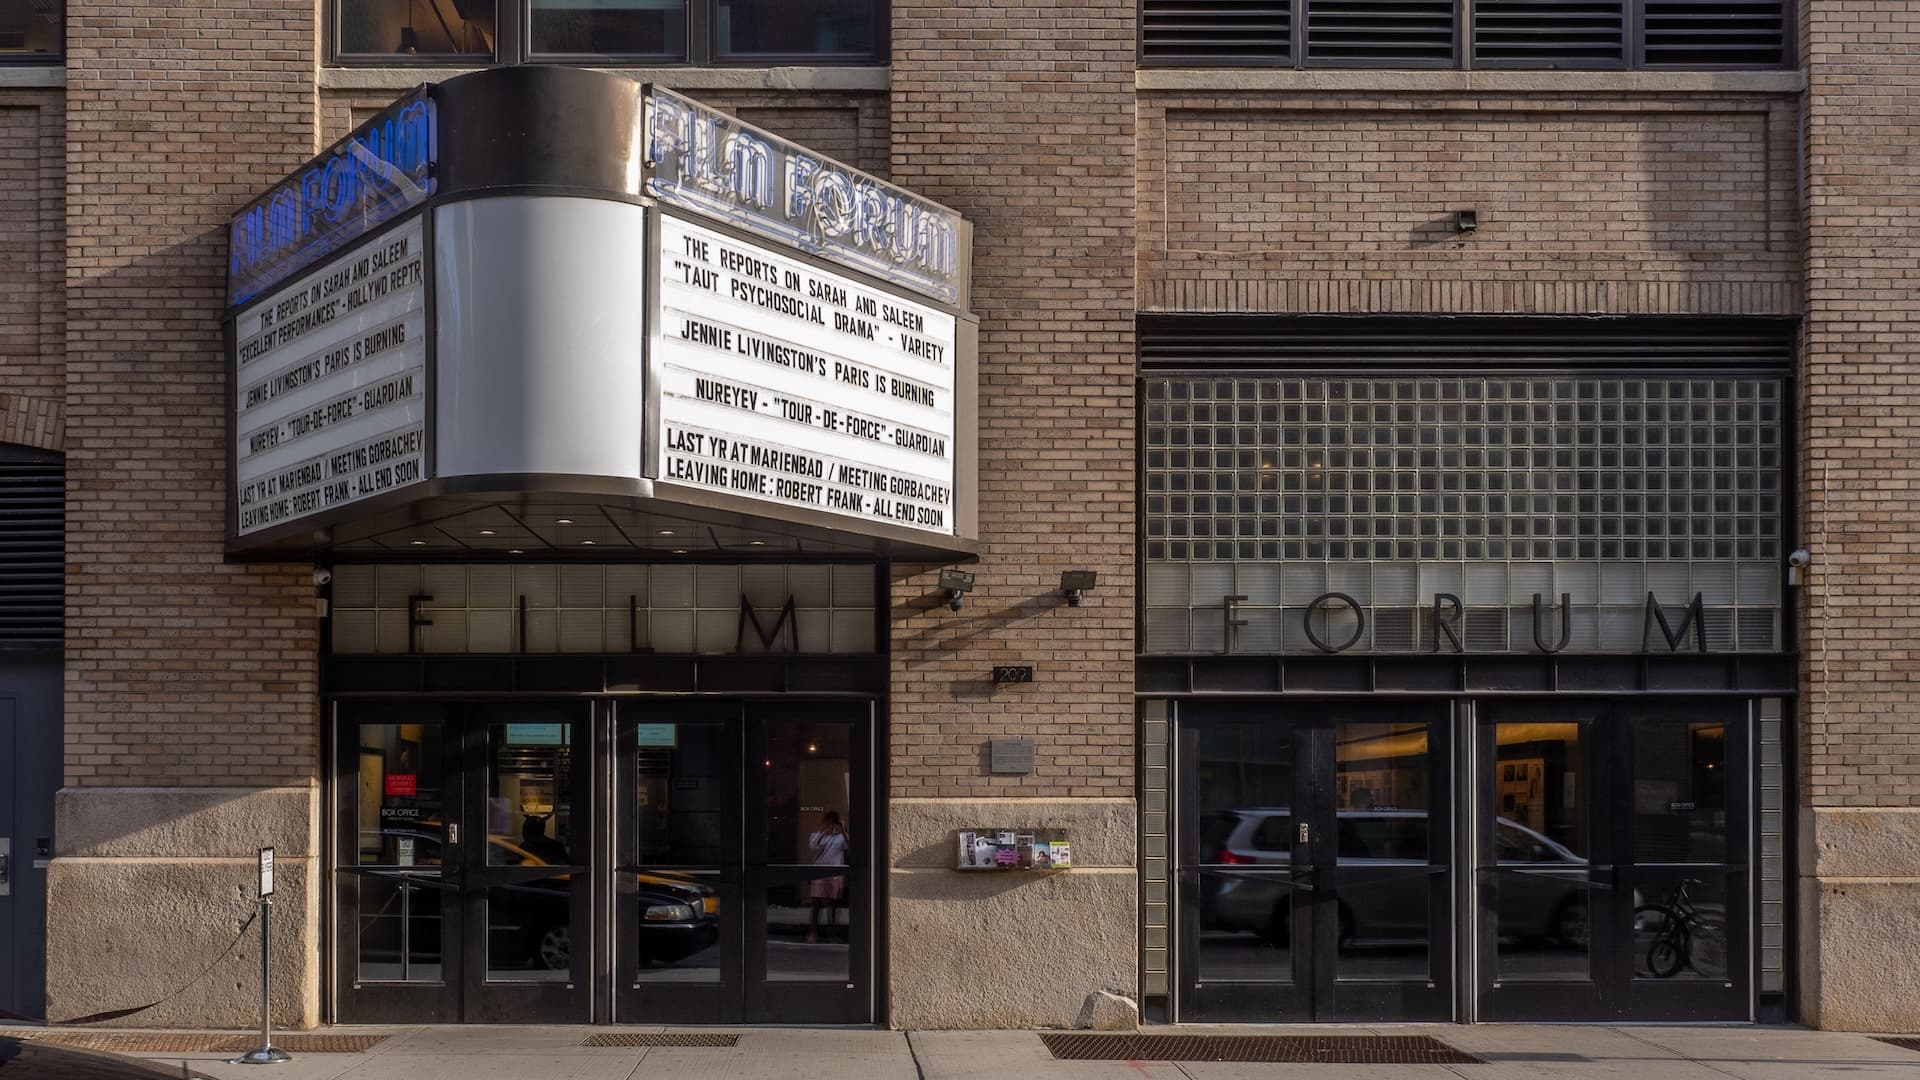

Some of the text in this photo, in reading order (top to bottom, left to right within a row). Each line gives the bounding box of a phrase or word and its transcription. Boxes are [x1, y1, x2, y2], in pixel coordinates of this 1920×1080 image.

[232, 101, 428, 275] FILM FORUM
[645, 97, 957, 279] FILM FORUM
[239, 330, 277, 364] "EXCELLENT
[278, 300, 340, 345] PERFORMANCES"
[348, 276, 387, 312] HOLLYWD
[261, 238, 408, 331] THE REPORTS ON SARAH AND SALEEM
[675, 260, 719, 292] "TAUT
[731, 279, 825, 326] PSYCHOSOCIAL
[834, 311, 880, 342] DRAMA"
[901, 334, 945, 363] VARIETY
[683, 235, 924, 334] THE REPORTS ON SARAH AND SALEEM
[246, 324, 405, 409] JENNIE LIVINGSTON'S PARIS IS BURNING
[681, 319, 935, 407] JENNIE LIVINGSTON'S PARIS IS BURNING
[250, 427, 280, 453] NUREYEV
[364, 376, 413, 410] GUARDIAN
[695, 378, 757, 411] NUREYEV
[895, 428, 945, 457] GUARDIAN
[240, 485, 255, 505] LAST
[257, 482, 266, 499] YR
[268, 478, 276, 496] AT
[279, 462, 321, 492] MARIENBAD
[331, 448, 367, 474] MEETING
[369, 430, 423, 463] GORBACHEV
[241, 506, 269, 529] LEAVING
[293, 489, 321, 513] ROBERT
[324, 480, 350, 505] FRANK
[359, 473, 374, 495] ALL
[375, 467, 391, 490] END
[395, 459, 420, 485] SOON
[667, 428, 704, 454] LAST
[709, 436, 727, 459] YR
[730, 441, 749, 463] AT
[752, 447, 823, 478] MARIENBAD
[839, 467, 887, 492] MEETING
[890, 476, 950, 505] GORBACHEV
[667, 456, 727, 487] LEAVING
[776, 480, 822, 505] ROBERT
[827, 488, 863, 513] FRANK
[873, 501, 893, 518] ALL
[896, 502, 915, 522] END
[918, 508, 944, 528] SOON
[408, 593, 799, 654] FILM
[1223, 591, 1707, 654] FORUM
[1000, 667, 1026, 682] 207
[382, 808, 420, 816] BOX OFFICE
